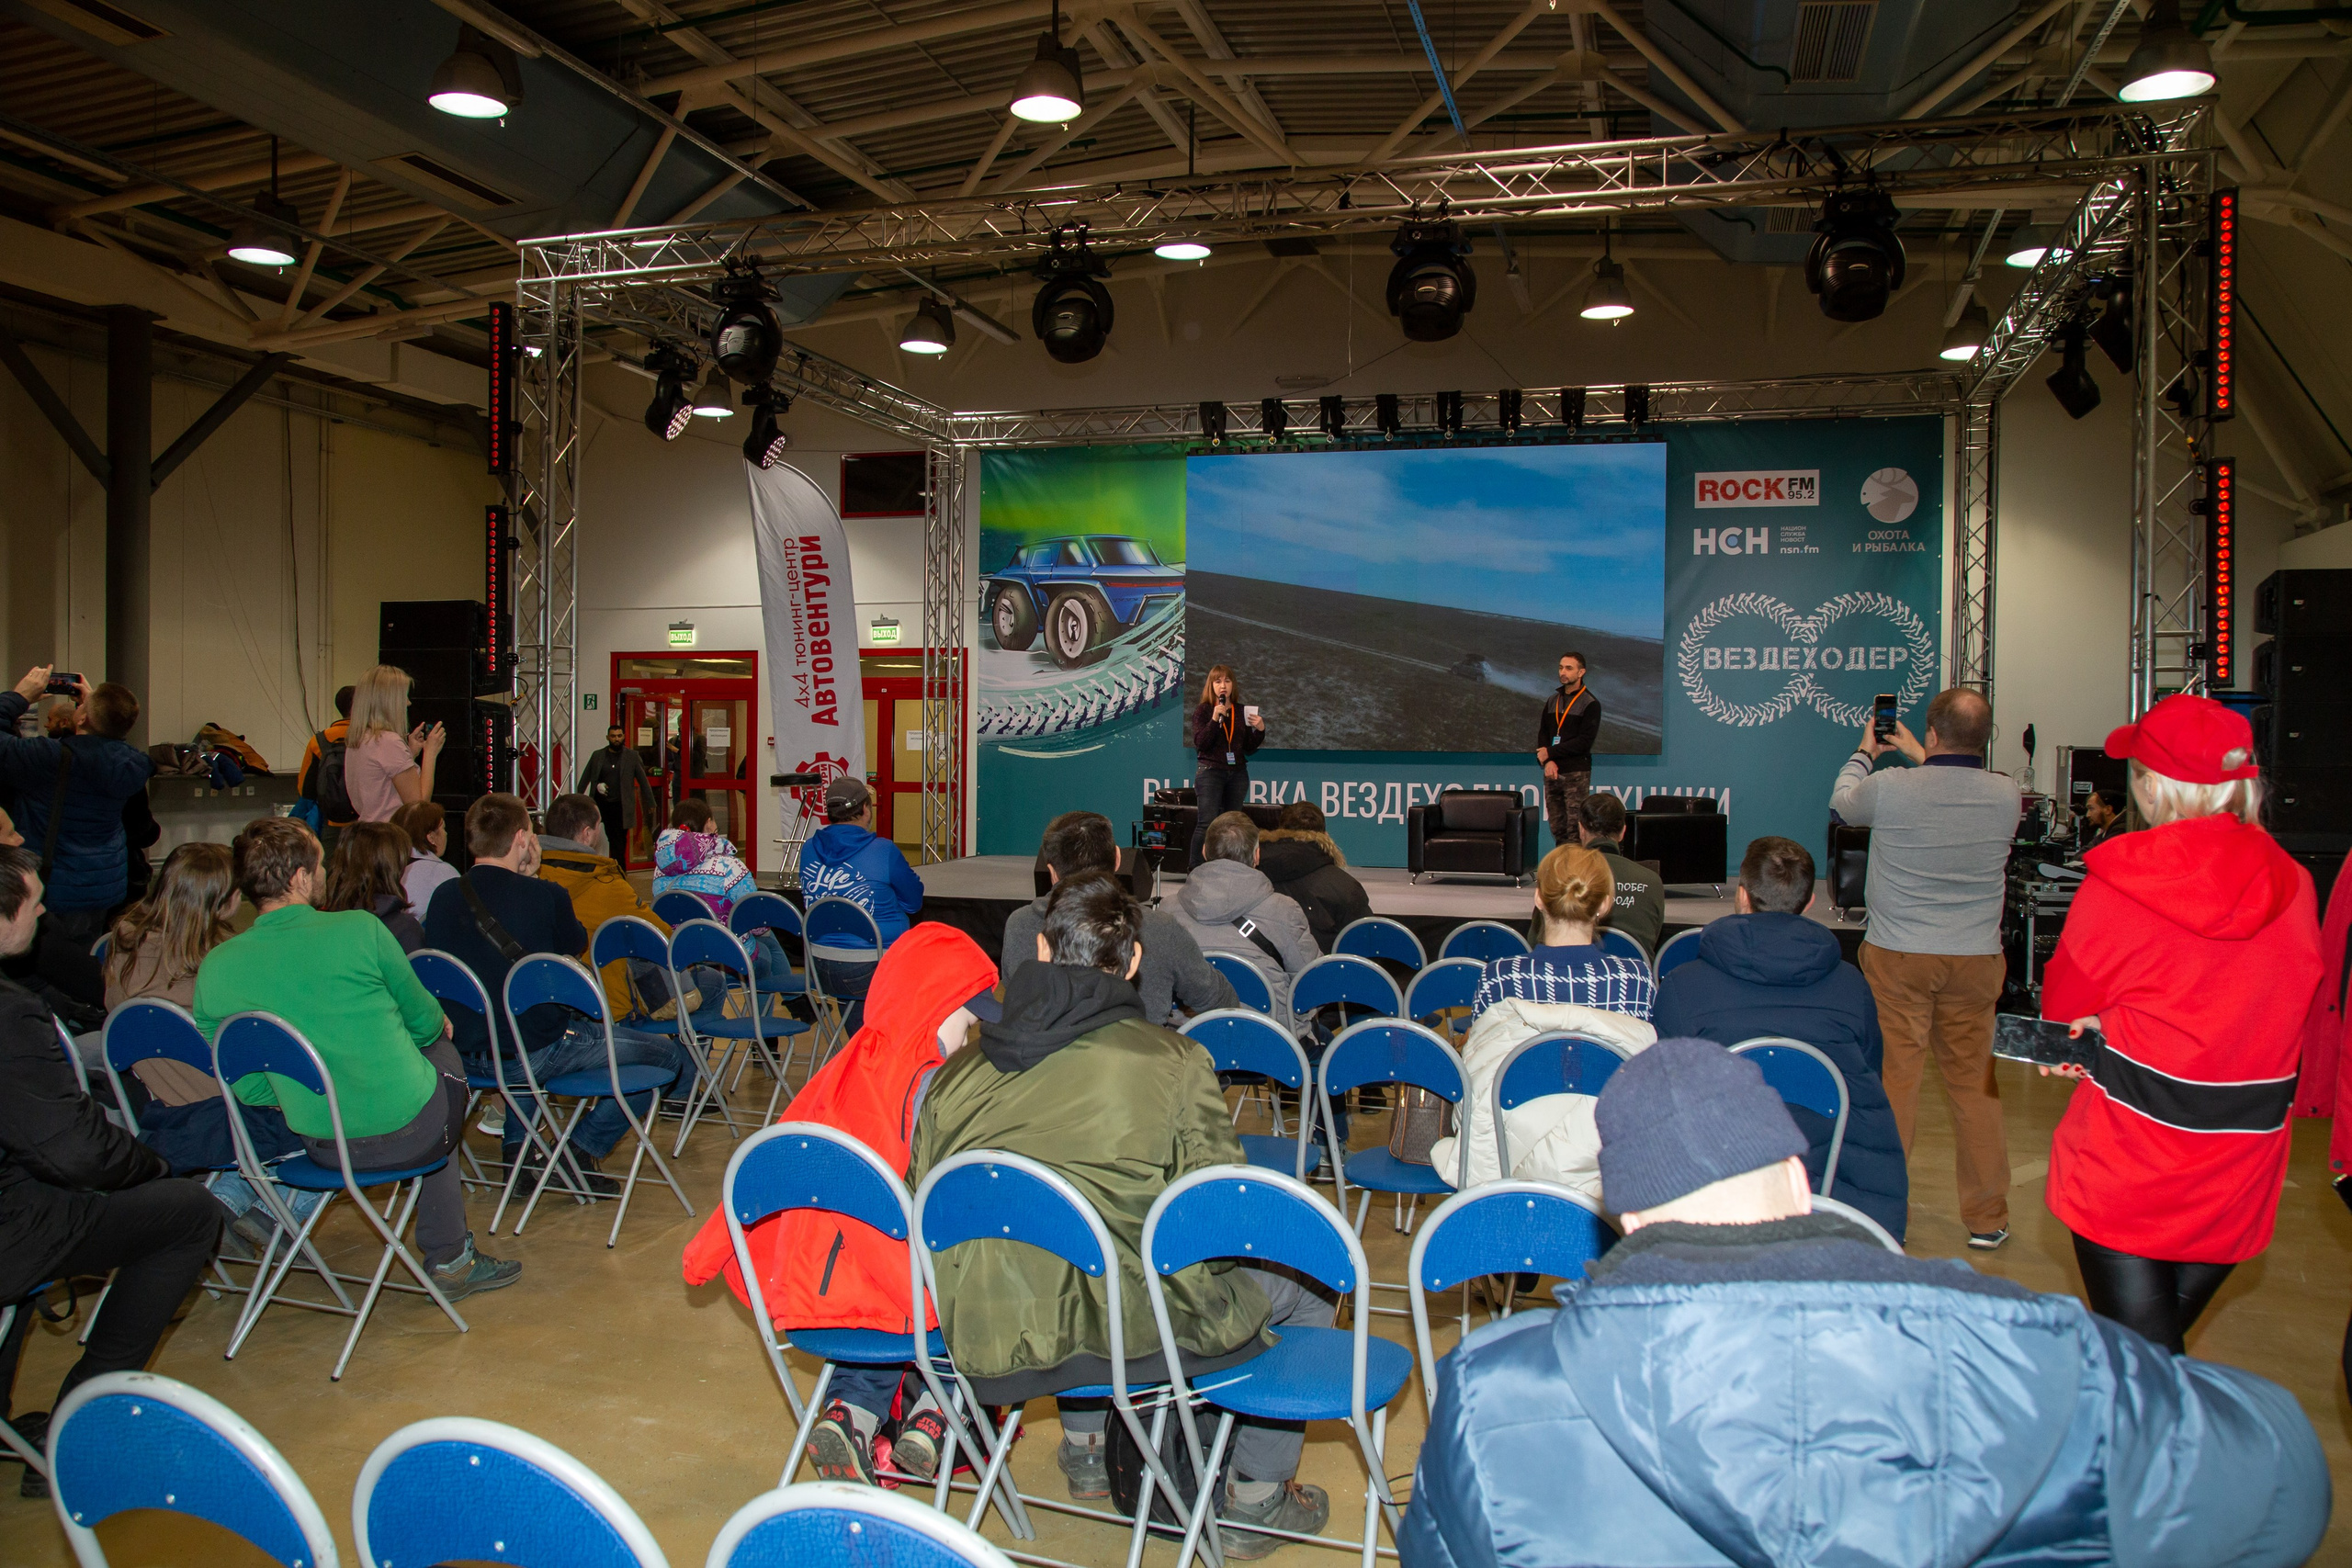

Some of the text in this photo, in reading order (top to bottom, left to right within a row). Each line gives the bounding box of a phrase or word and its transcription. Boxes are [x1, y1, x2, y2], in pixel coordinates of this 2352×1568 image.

[1699, 477, 1815, 502] ROCK FM
[1788, 490, 1815, 500] 95.2
[1693, 526, 1769, 556] НСН
[1868, 530, 1910, 540] ОХОТА
[1780, 545, 1819, 554] nsn.fm
[1852, 542, 1926, 553] И РЫБАЛКА
[783, 538, 807, 667] тюнинг-центр
[671, 633, 692, 642] ВЫХОД
[873, 629, 897, 639] ВЫХОД
[1703, 646, 1909, 671] ВЕЗДЕХОДЕР
[808, 864, 854, 893] Life
[1616, 882, 1648, 893] ПОБЕГ
[1612, 896, 1635, 908] ОДА
[915, 1422, 940, 1440] WARS
[917, 1416, 942, 1436] STAR
